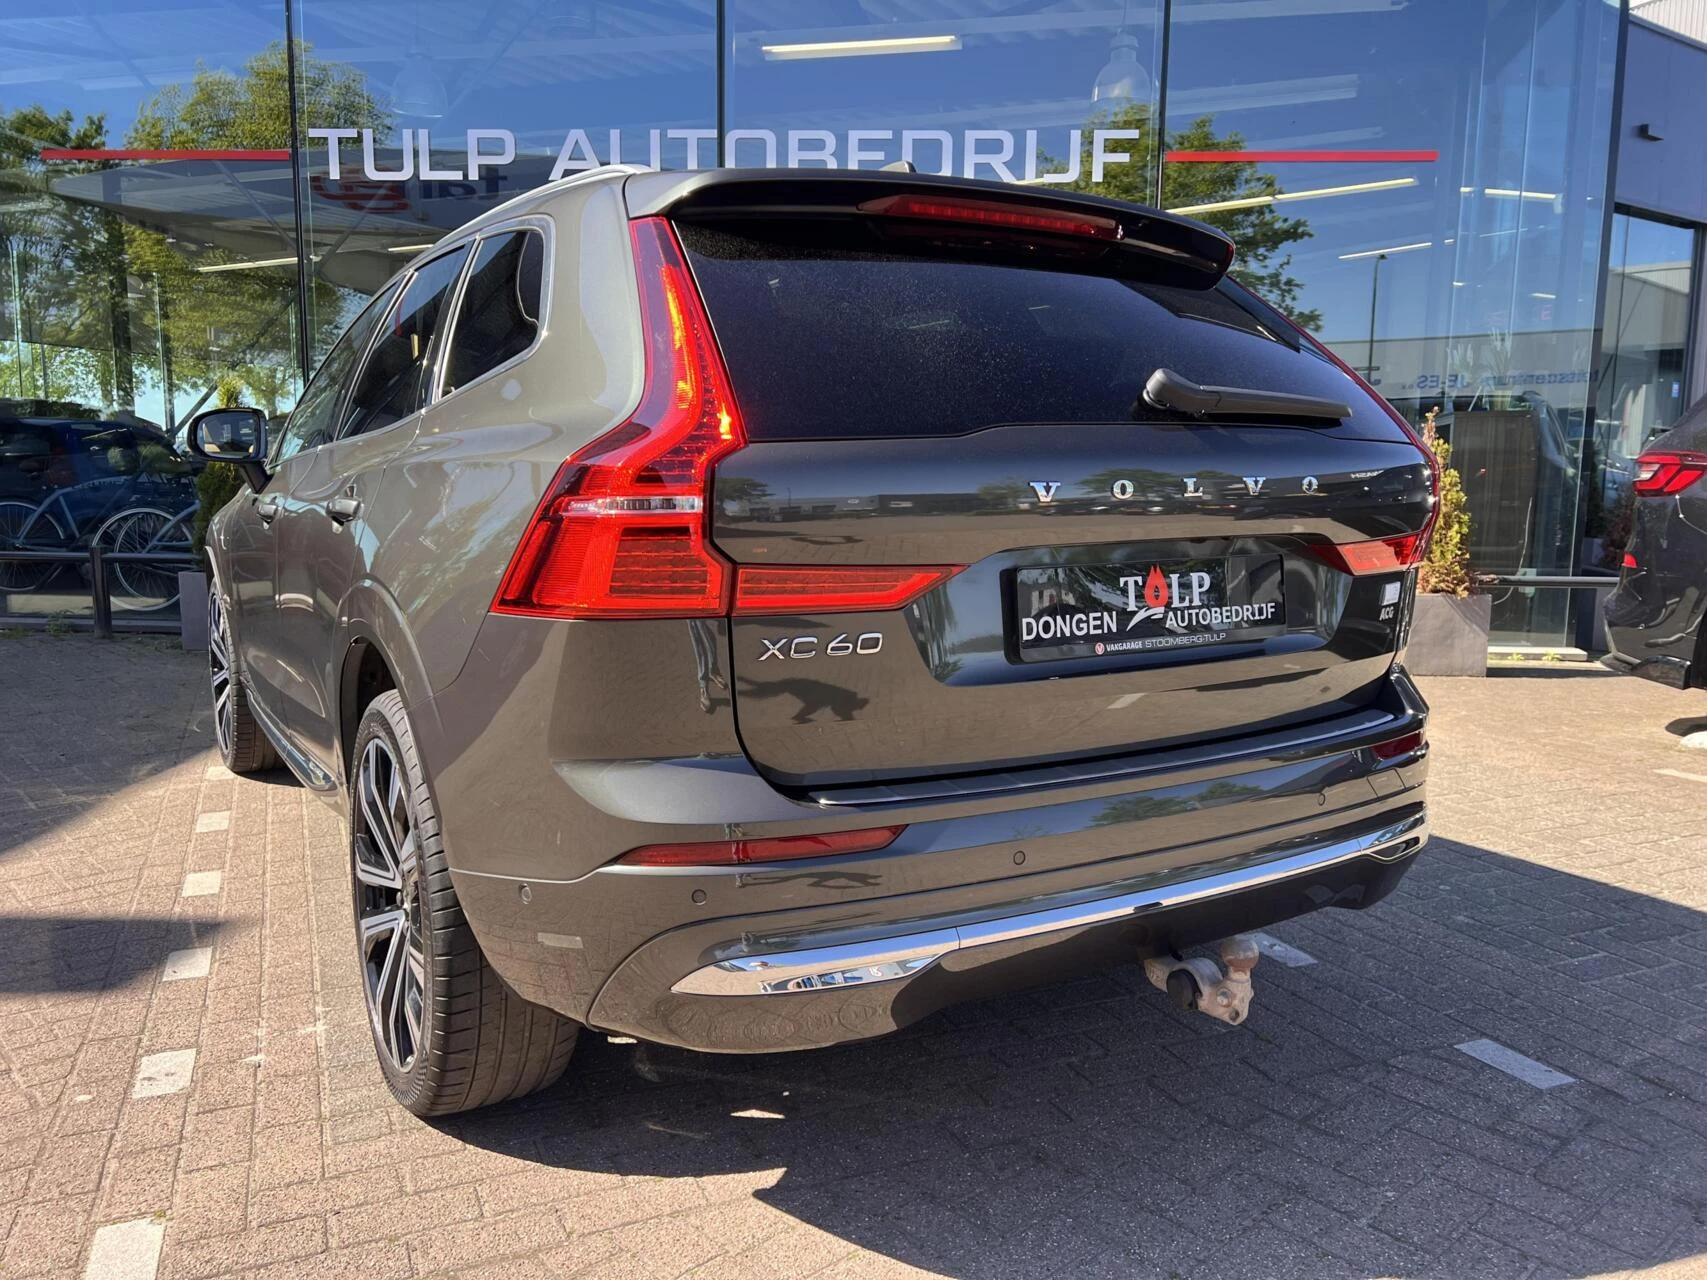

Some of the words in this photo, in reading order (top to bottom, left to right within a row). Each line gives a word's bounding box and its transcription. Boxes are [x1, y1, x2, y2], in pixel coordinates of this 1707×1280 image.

[308, 128, 516, 181] TULP
[549, 129, 1140, 183] AUTOBEDRIJF
[1029, 476, 1319, 502] VOLVO
[1022, 611, 1118, 641] DONGEN
[1165, 602, 1276, 629] AUTOBEDRIJF
[1106, 640, 1143, 652] VAKGARAGE
